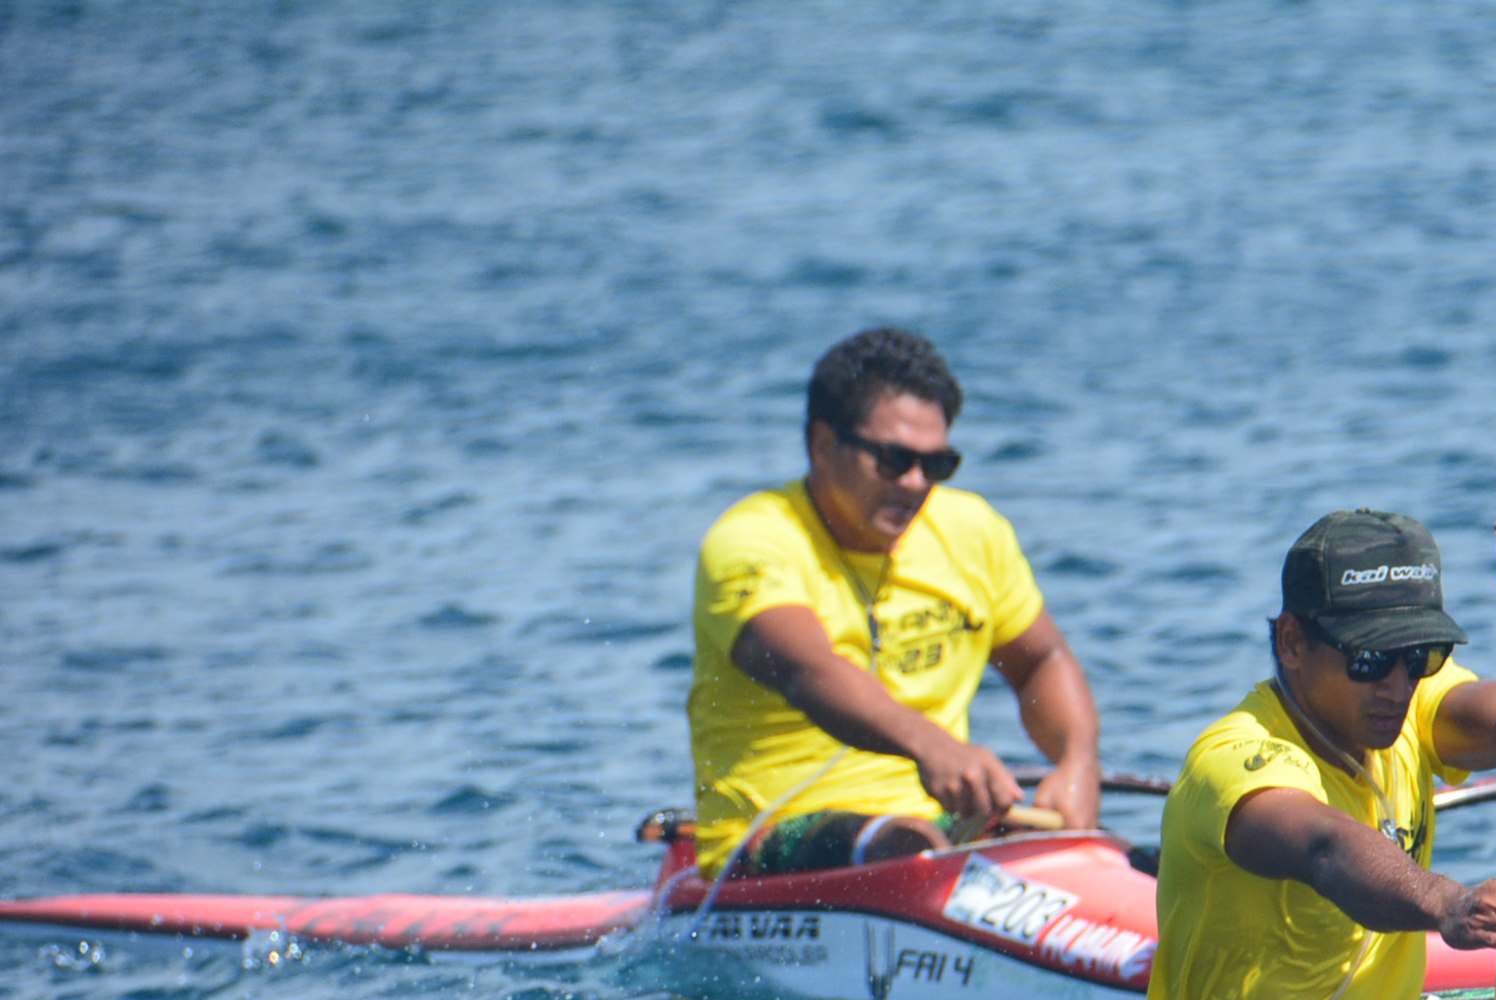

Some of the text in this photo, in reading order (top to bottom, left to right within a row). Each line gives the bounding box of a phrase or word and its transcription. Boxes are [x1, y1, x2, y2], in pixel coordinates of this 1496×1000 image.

[1341, 565, 1388, 585] kai
[981, 882, 1068, 939] 203
[897, 949, 975, 986] FAI 4
